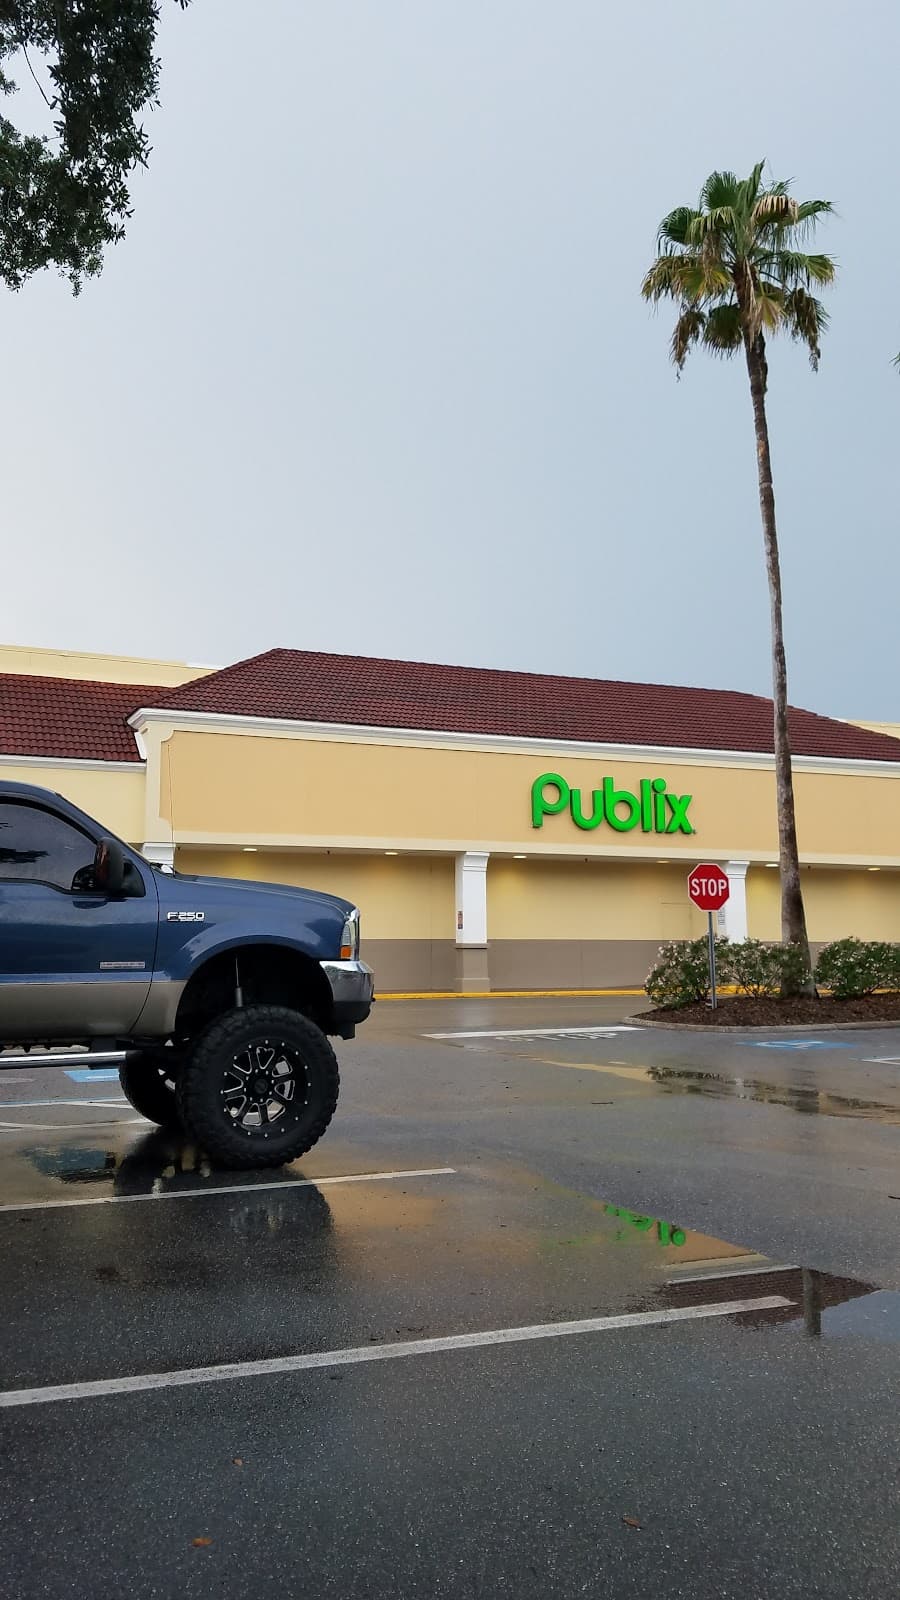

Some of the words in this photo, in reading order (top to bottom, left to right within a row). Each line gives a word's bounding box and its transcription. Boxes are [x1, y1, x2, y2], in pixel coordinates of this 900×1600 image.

[531, 772, 693, 834] Publix
[690, 878, 728, 897] STOP
[167, 911, 205, 921] F250
